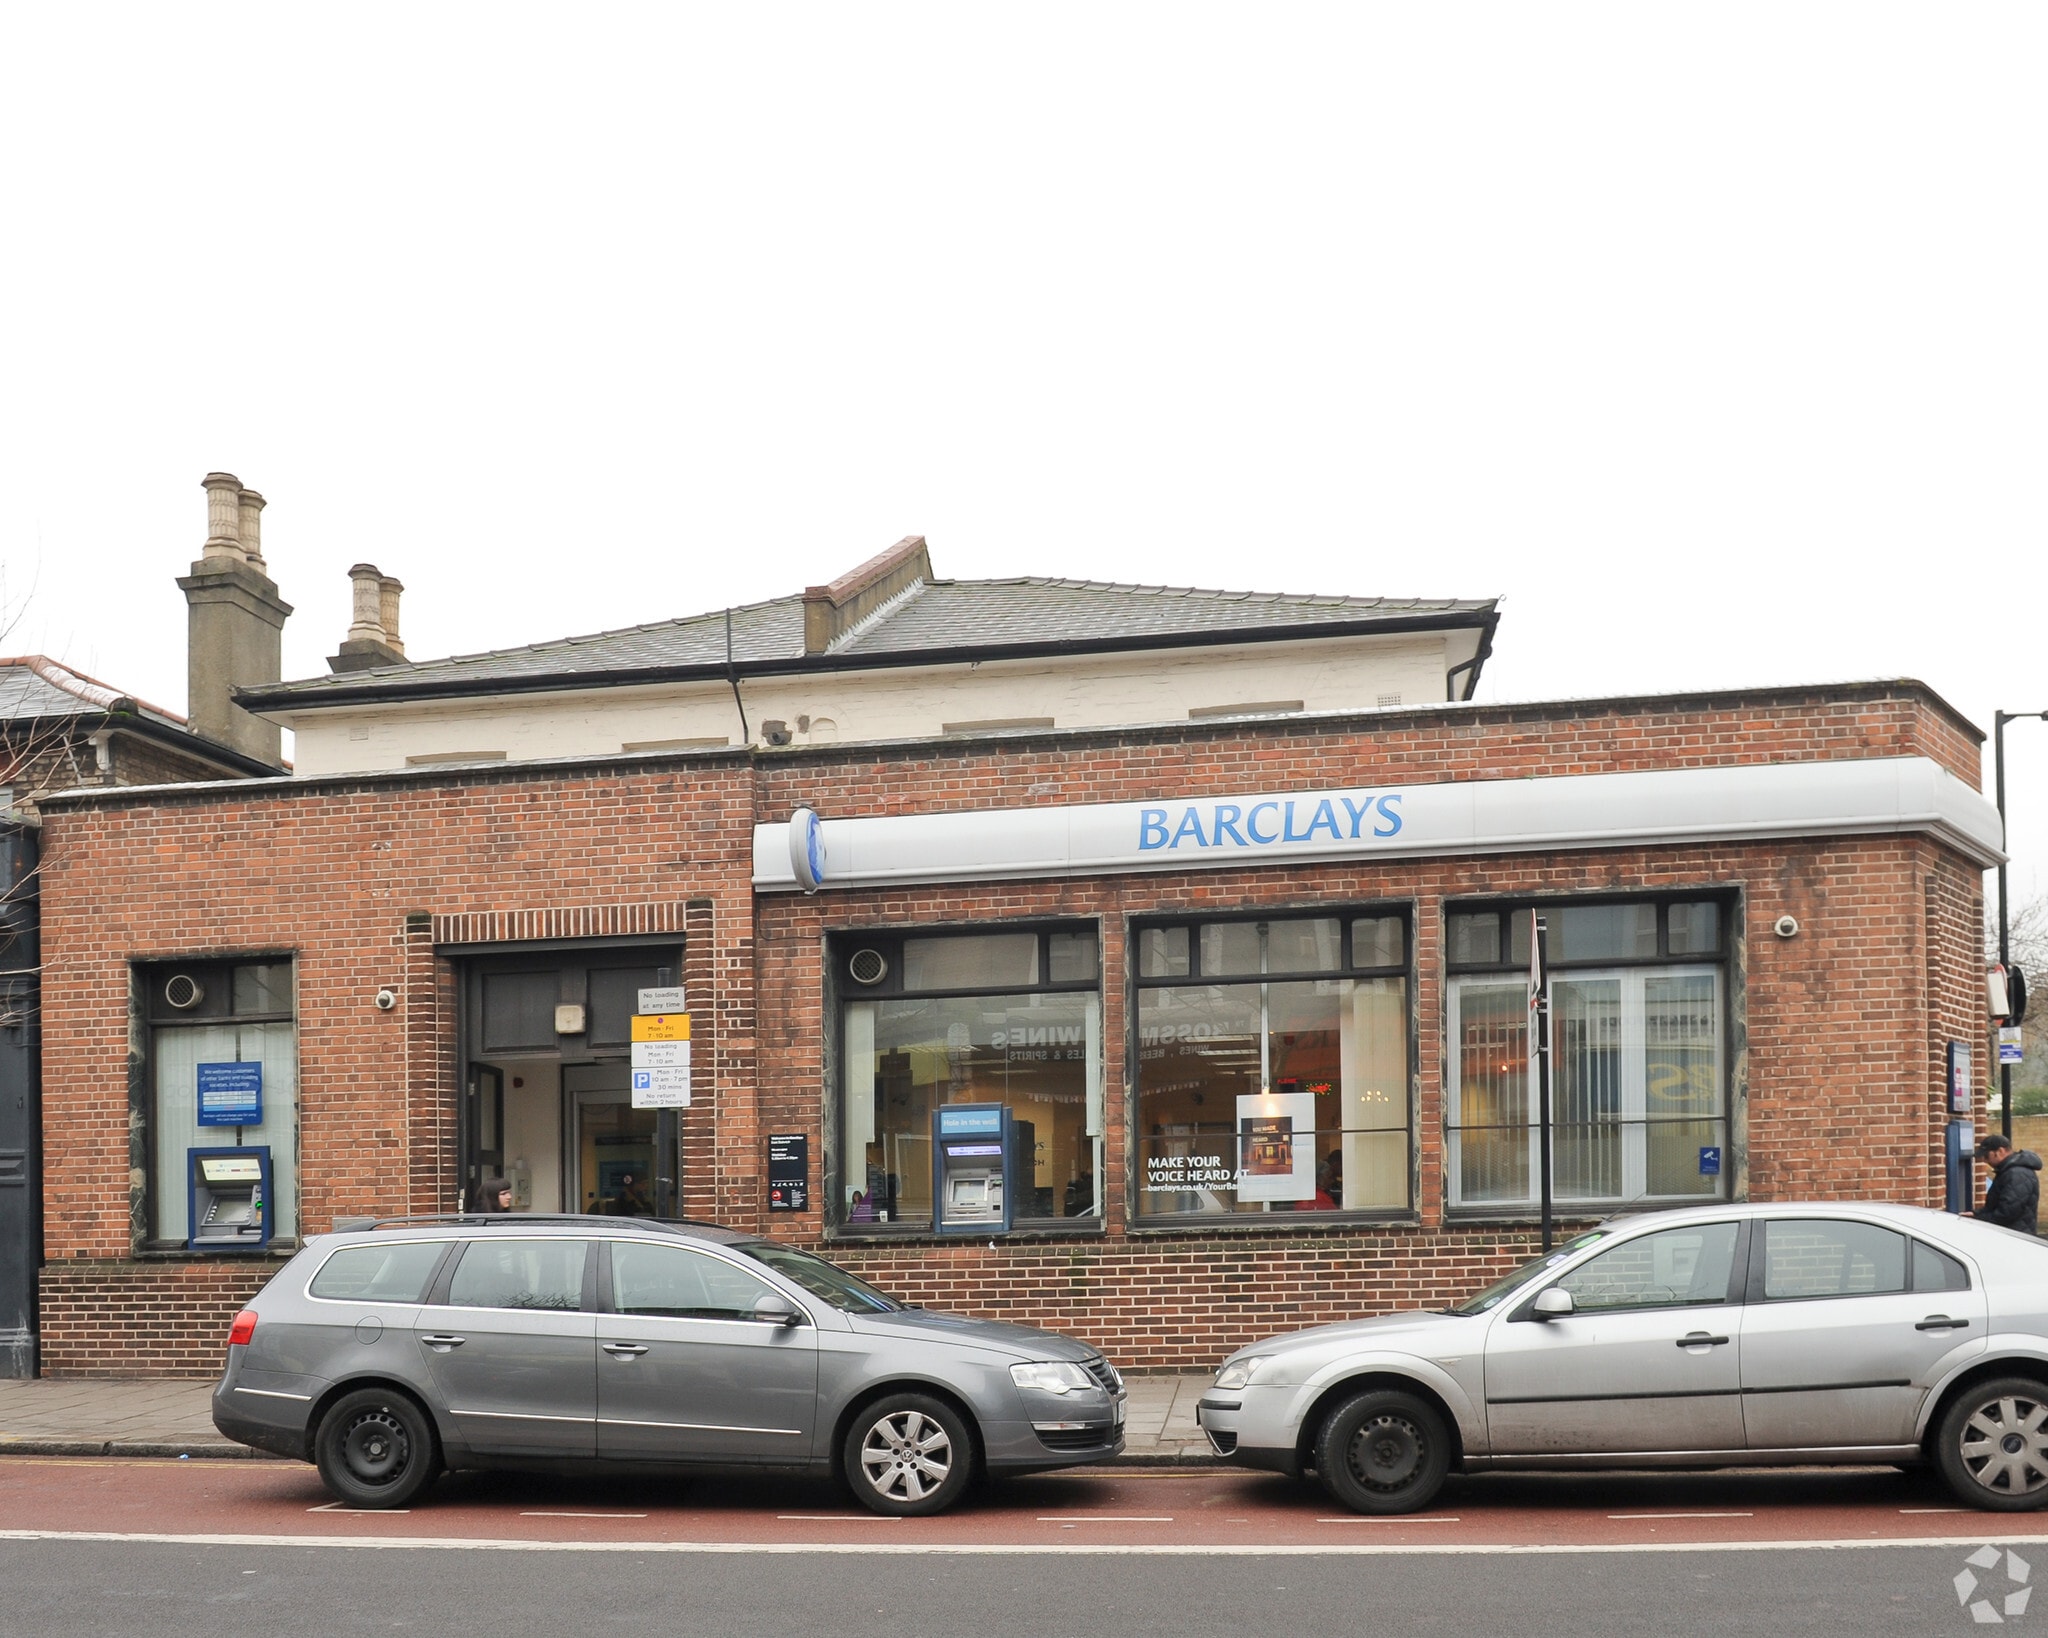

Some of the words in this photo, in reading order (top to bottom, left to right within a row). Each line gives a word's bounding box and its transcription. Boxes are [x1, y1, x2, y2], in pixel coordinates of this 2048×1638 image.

[1138, 794, 1402, 850] BARCLAYS
[1147, 1157, 1184, 1168] MAKE
[1187, 1155, 1221, 1167] YOUR
[1147, 1170, 1185, 1182] VOICE
[1187, 1169, 1231, 1181] HEARD
[1233, 1169, 1250, 1180] AT
